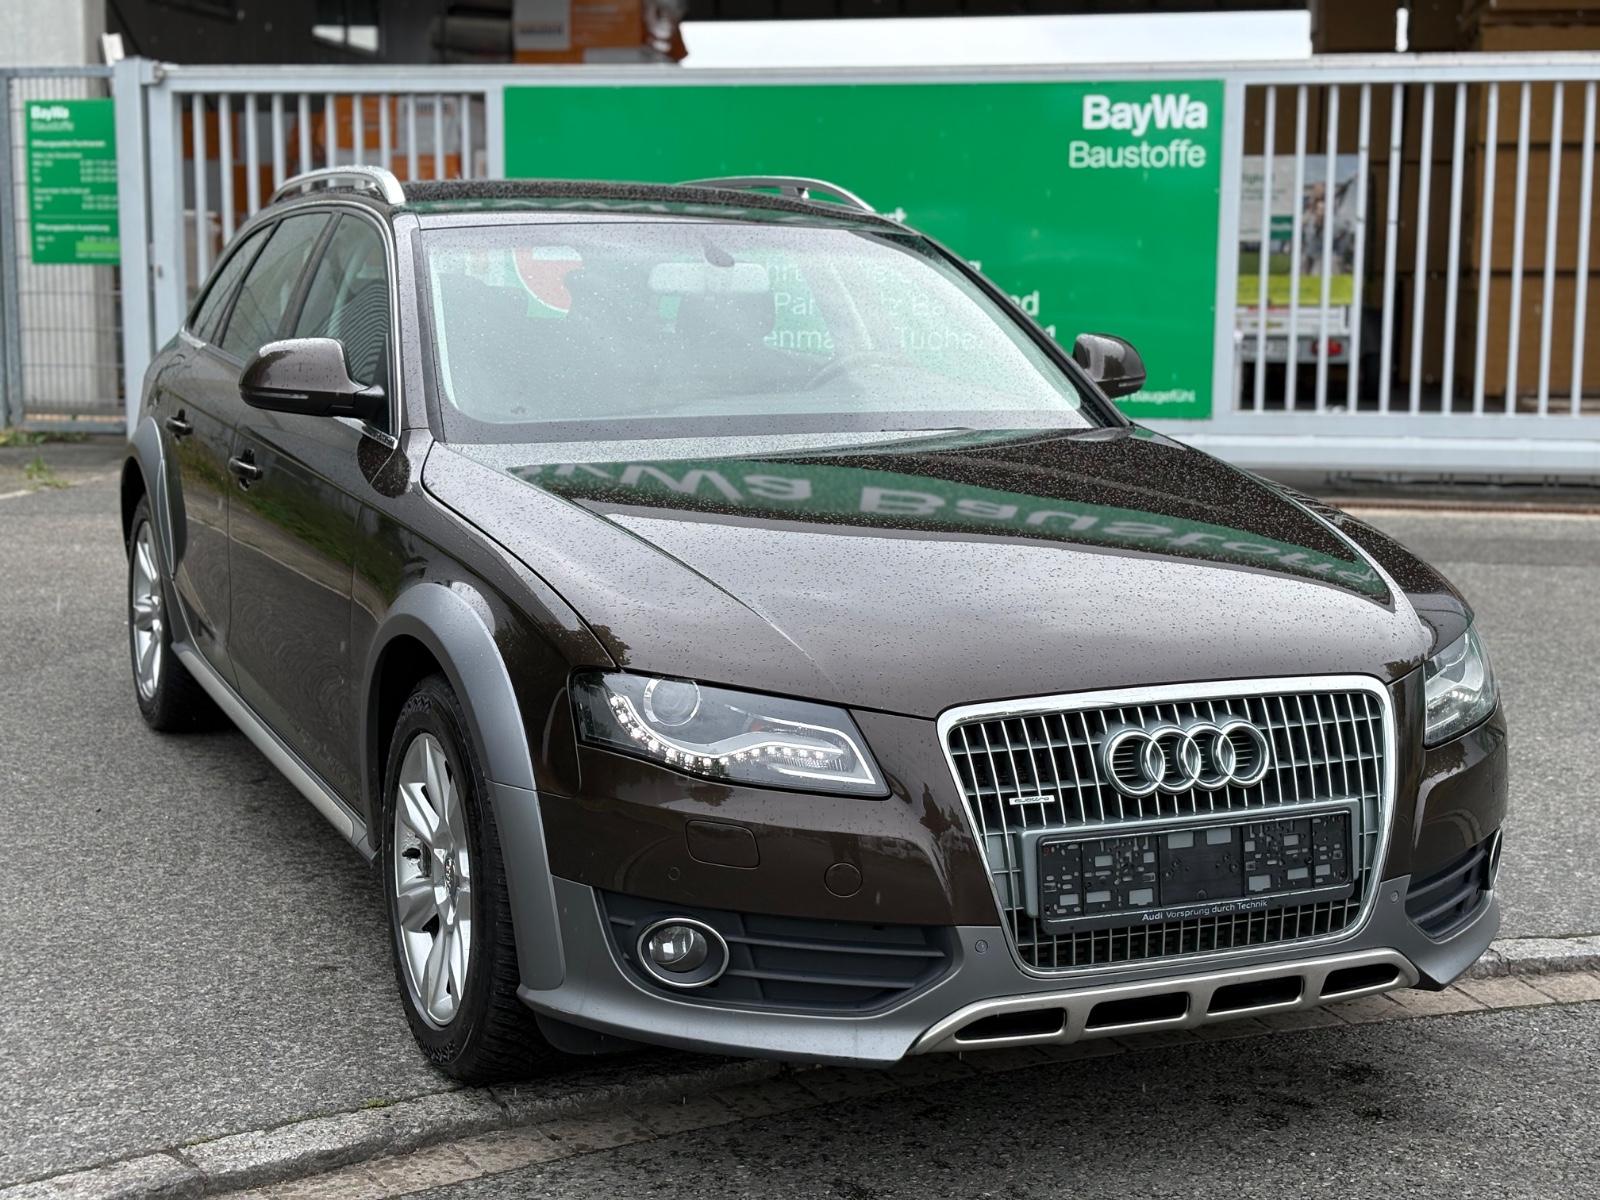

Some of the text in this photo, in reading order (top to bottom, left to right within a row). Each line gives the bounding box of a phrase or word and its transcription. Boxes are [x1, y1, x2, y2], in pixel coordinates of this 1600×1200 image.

[1082, 93, 1208, 137] BayWa
[1068, 139, 1207, 168] Baustoffe
[1142, 900, 1268, 921] Audi Vorsprung durch Technik
